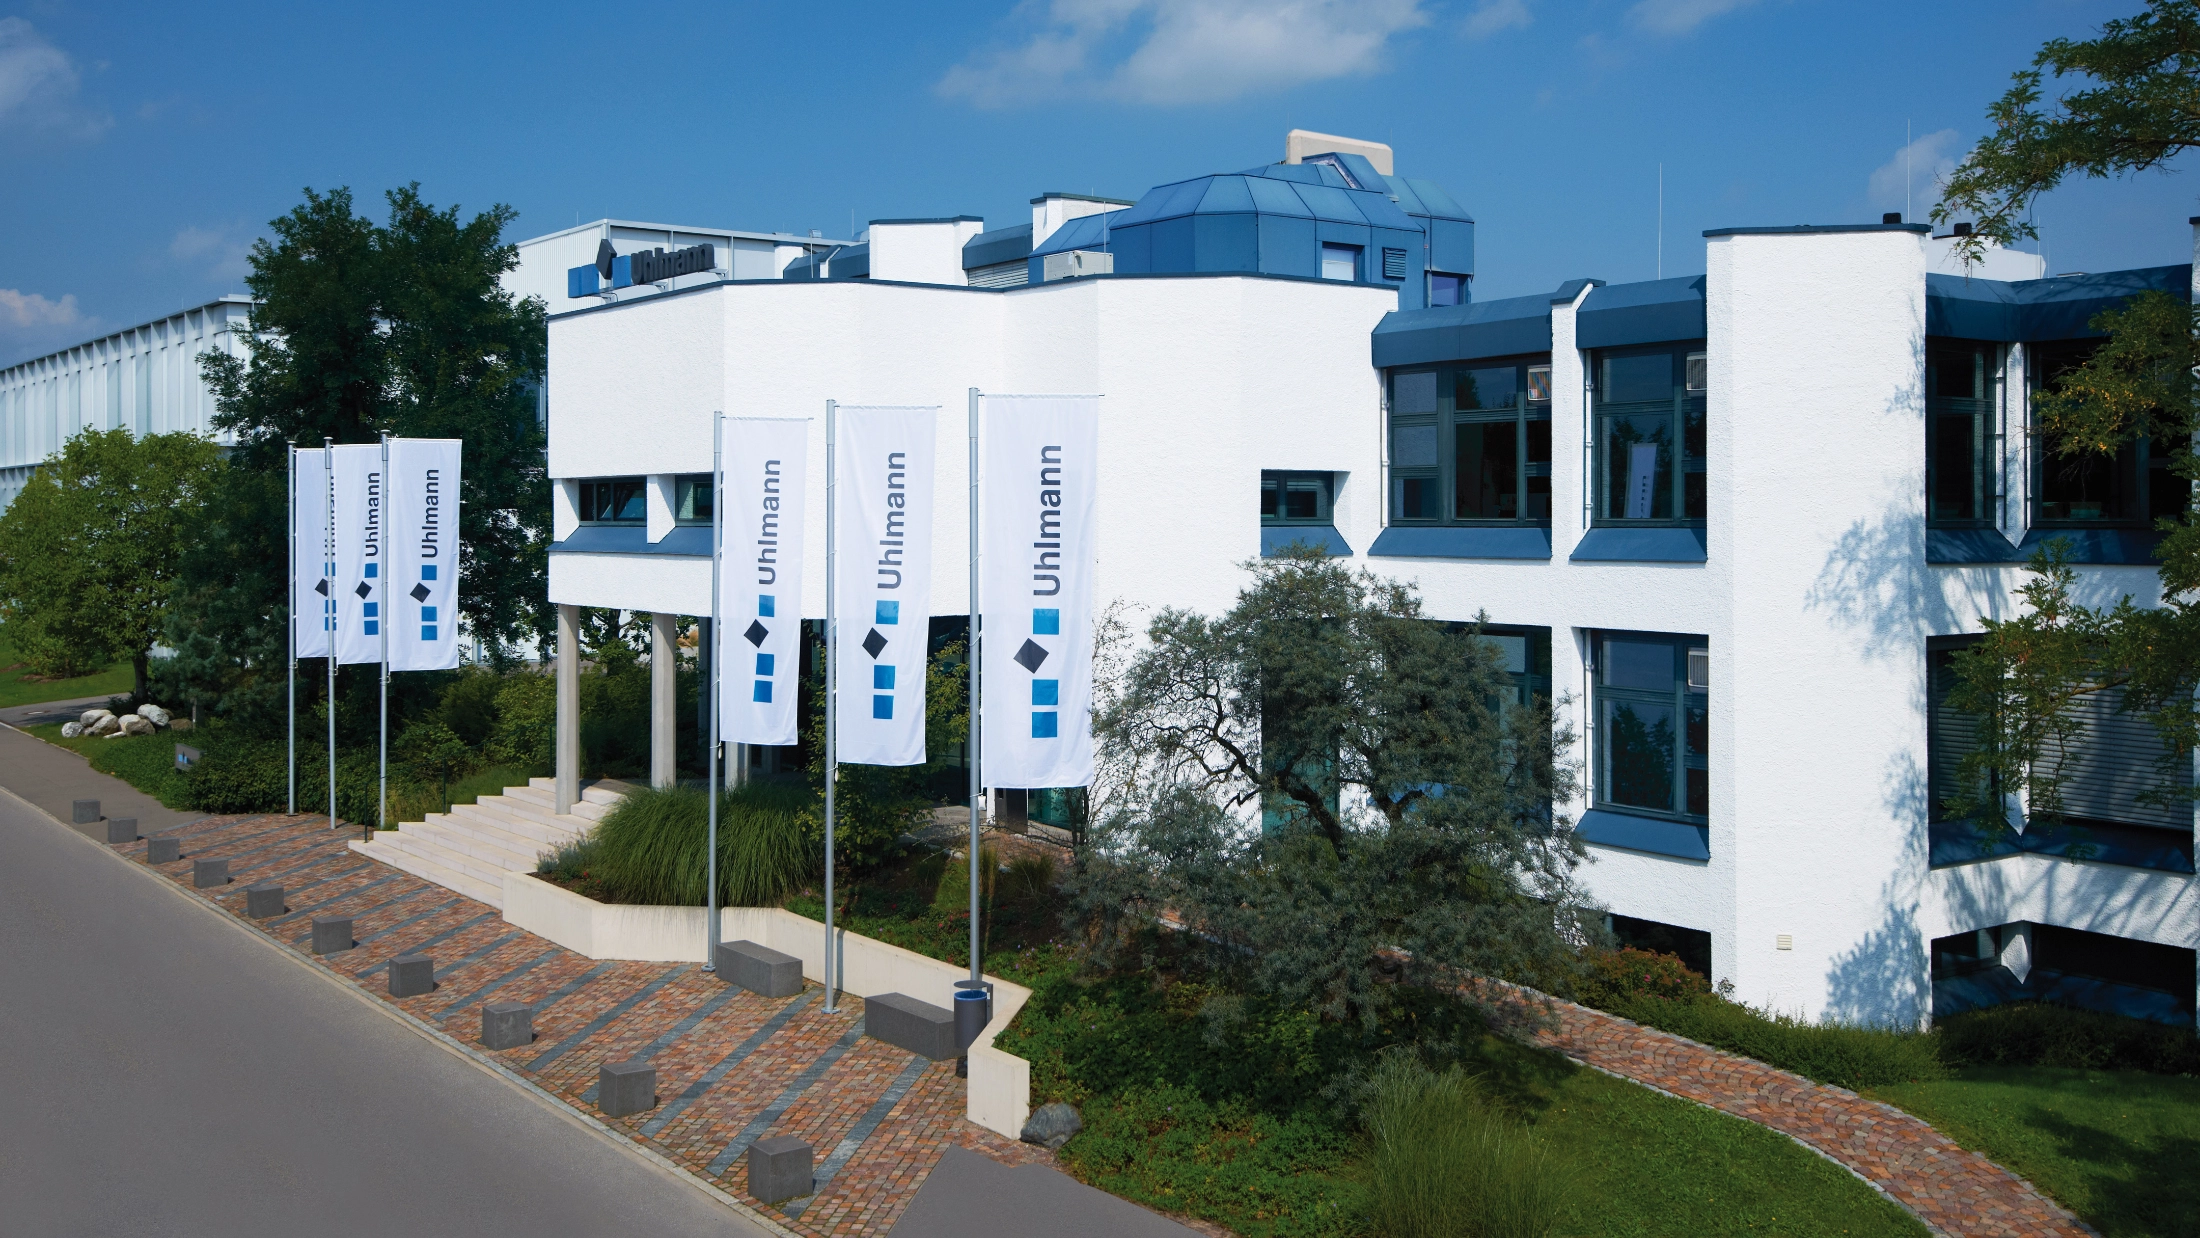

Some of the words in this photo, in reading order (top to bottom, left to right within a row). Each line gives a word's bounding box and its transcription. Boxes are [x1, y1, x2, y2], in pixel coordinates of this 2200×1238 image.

[631, 243, 715, 285] Uhlmann
[365, 472, 380, 557] Uhlmann
[421, 469, 439, 558] Uhlmann
[758, 459, 781, 585] Uhlmann
[877, 452, 905, 589] Uhlmann
[1033, 445, 1062, 596] Uhlmann
